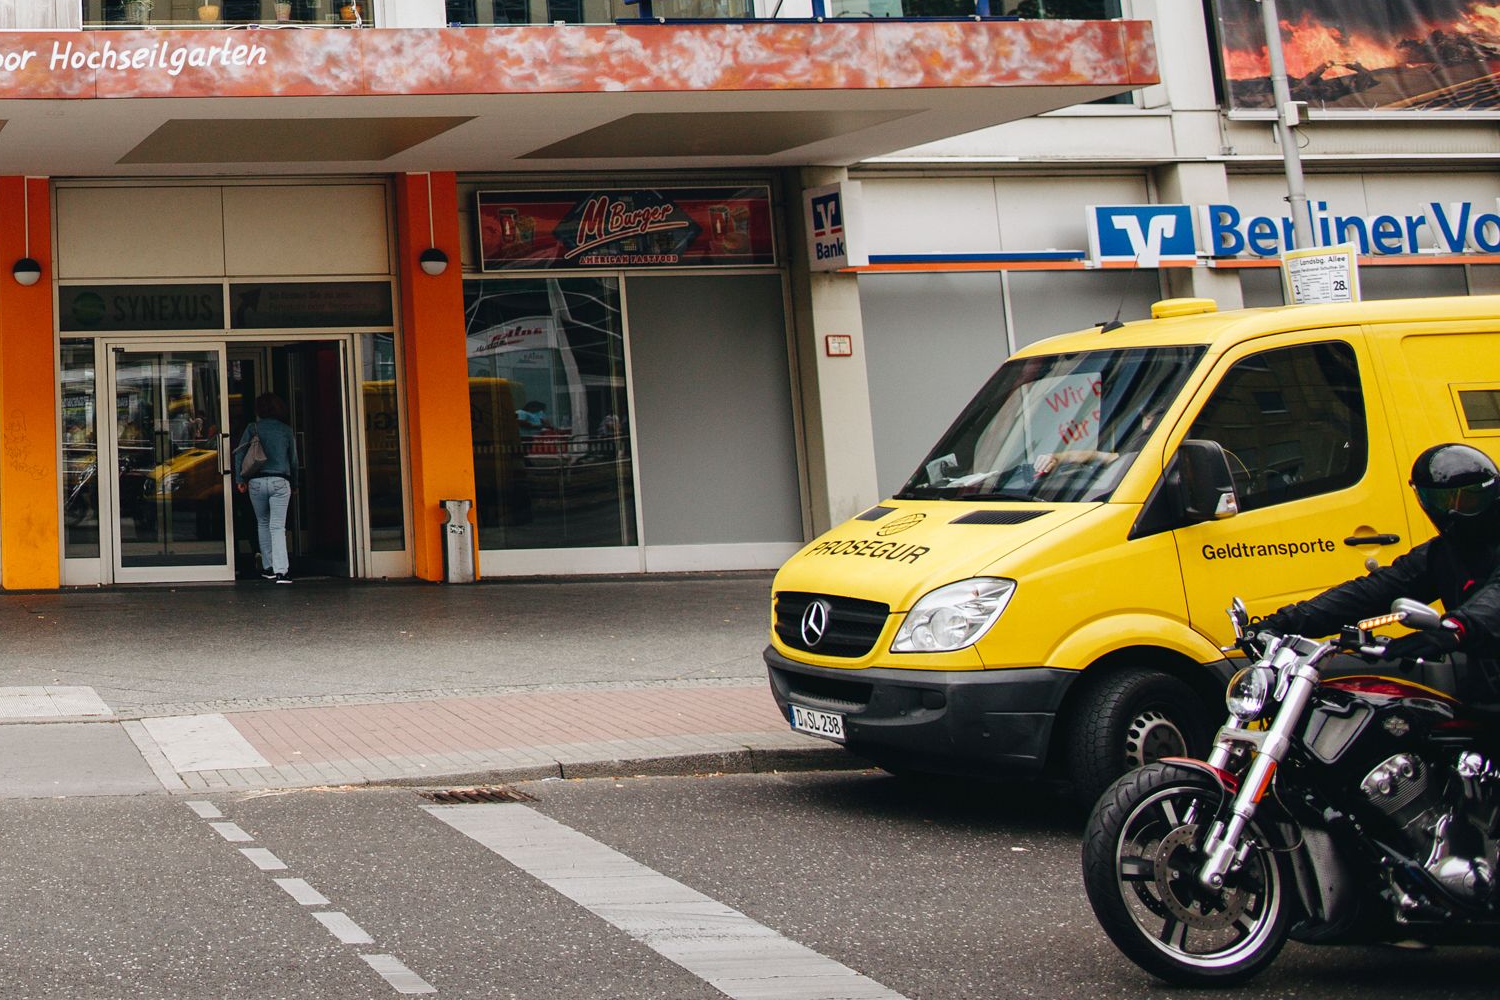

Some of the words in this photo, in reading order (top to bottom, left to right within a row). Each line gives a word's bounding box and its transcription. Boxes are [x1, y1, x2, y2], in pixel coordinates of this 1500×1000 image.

[49, 37, 267, 76] Hochseilgarten
[609, 201, 674, 234] Burger
[579, 255, 630, 265] AMERICAN
[816, 237, 845, 260] Bank
[1328, 255, 1346, 263] Allee
[1333, 280, 1348, 291] 28.
[113, 294, 214, 322] SYNEXUS
[1045, 385, 1085, 413] Wir
[804, 540, 930, 564] PROSEGUR
[1202, 538, 1336, 561] Geldtransporte
[820, 714, 841, 735] 238
